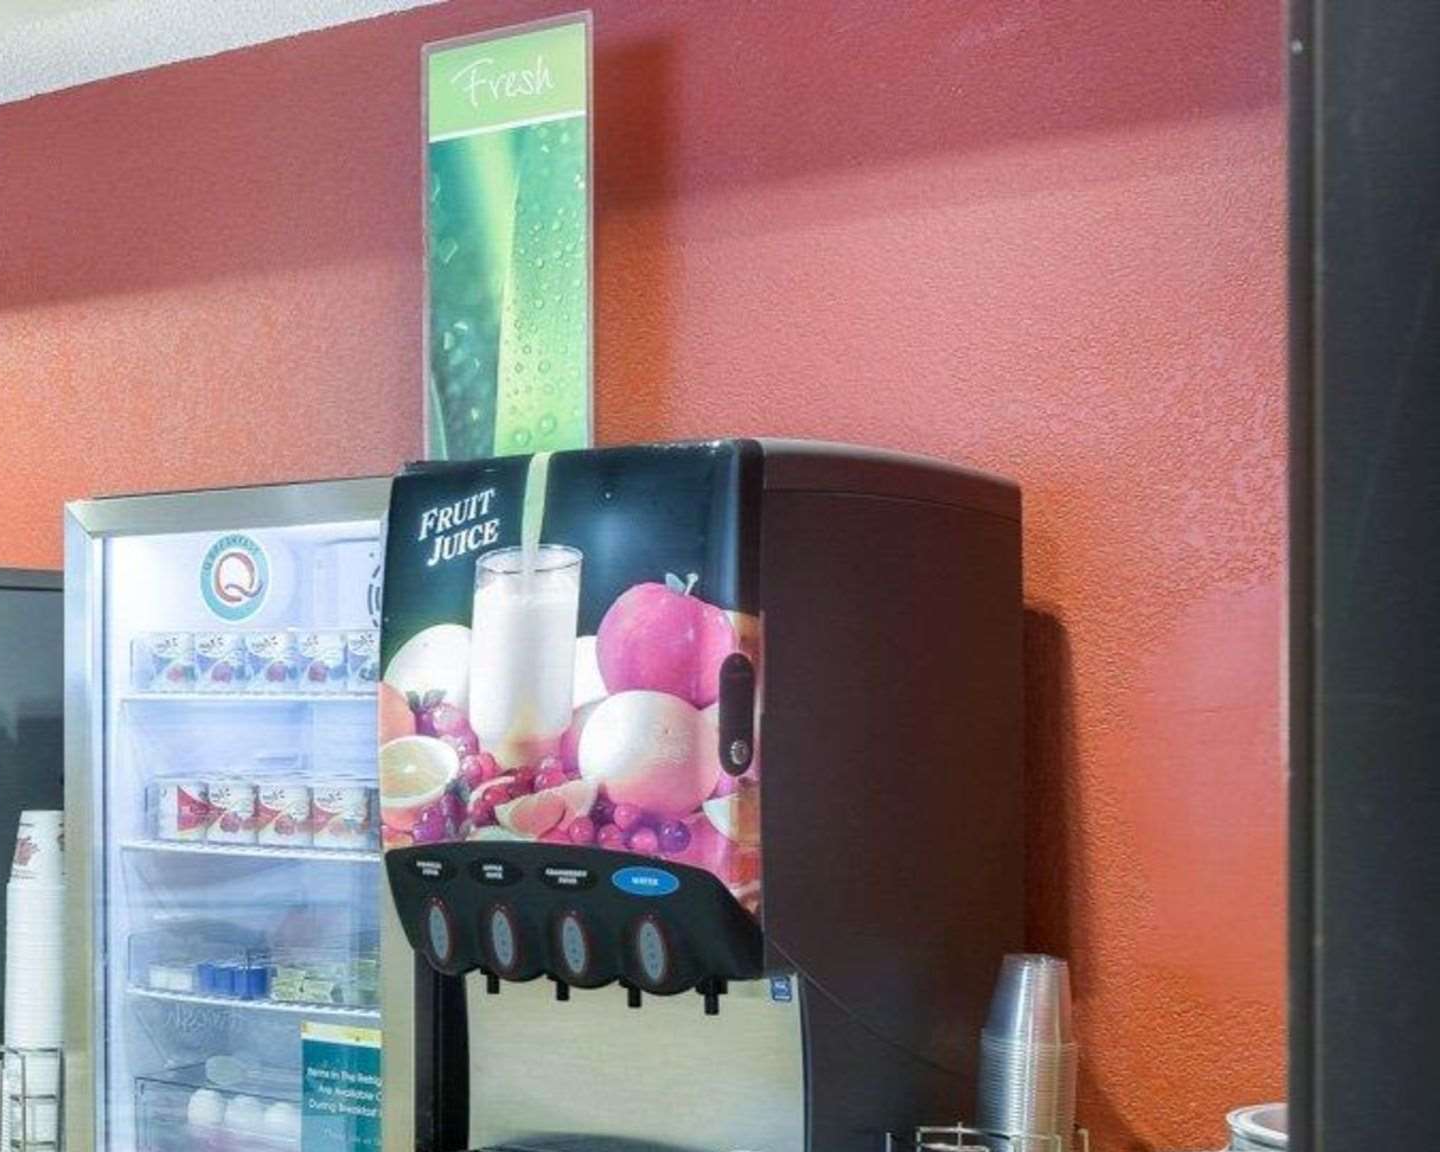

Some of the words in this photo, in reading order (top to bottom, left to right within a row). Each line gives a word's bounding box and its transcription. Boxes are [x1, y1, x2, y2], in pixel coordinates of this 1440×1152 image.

[450, 56, 556, 108] Fresh
[418, 488, 496, 541] FRUIT
[426, 518, 500, 566] JUICE
